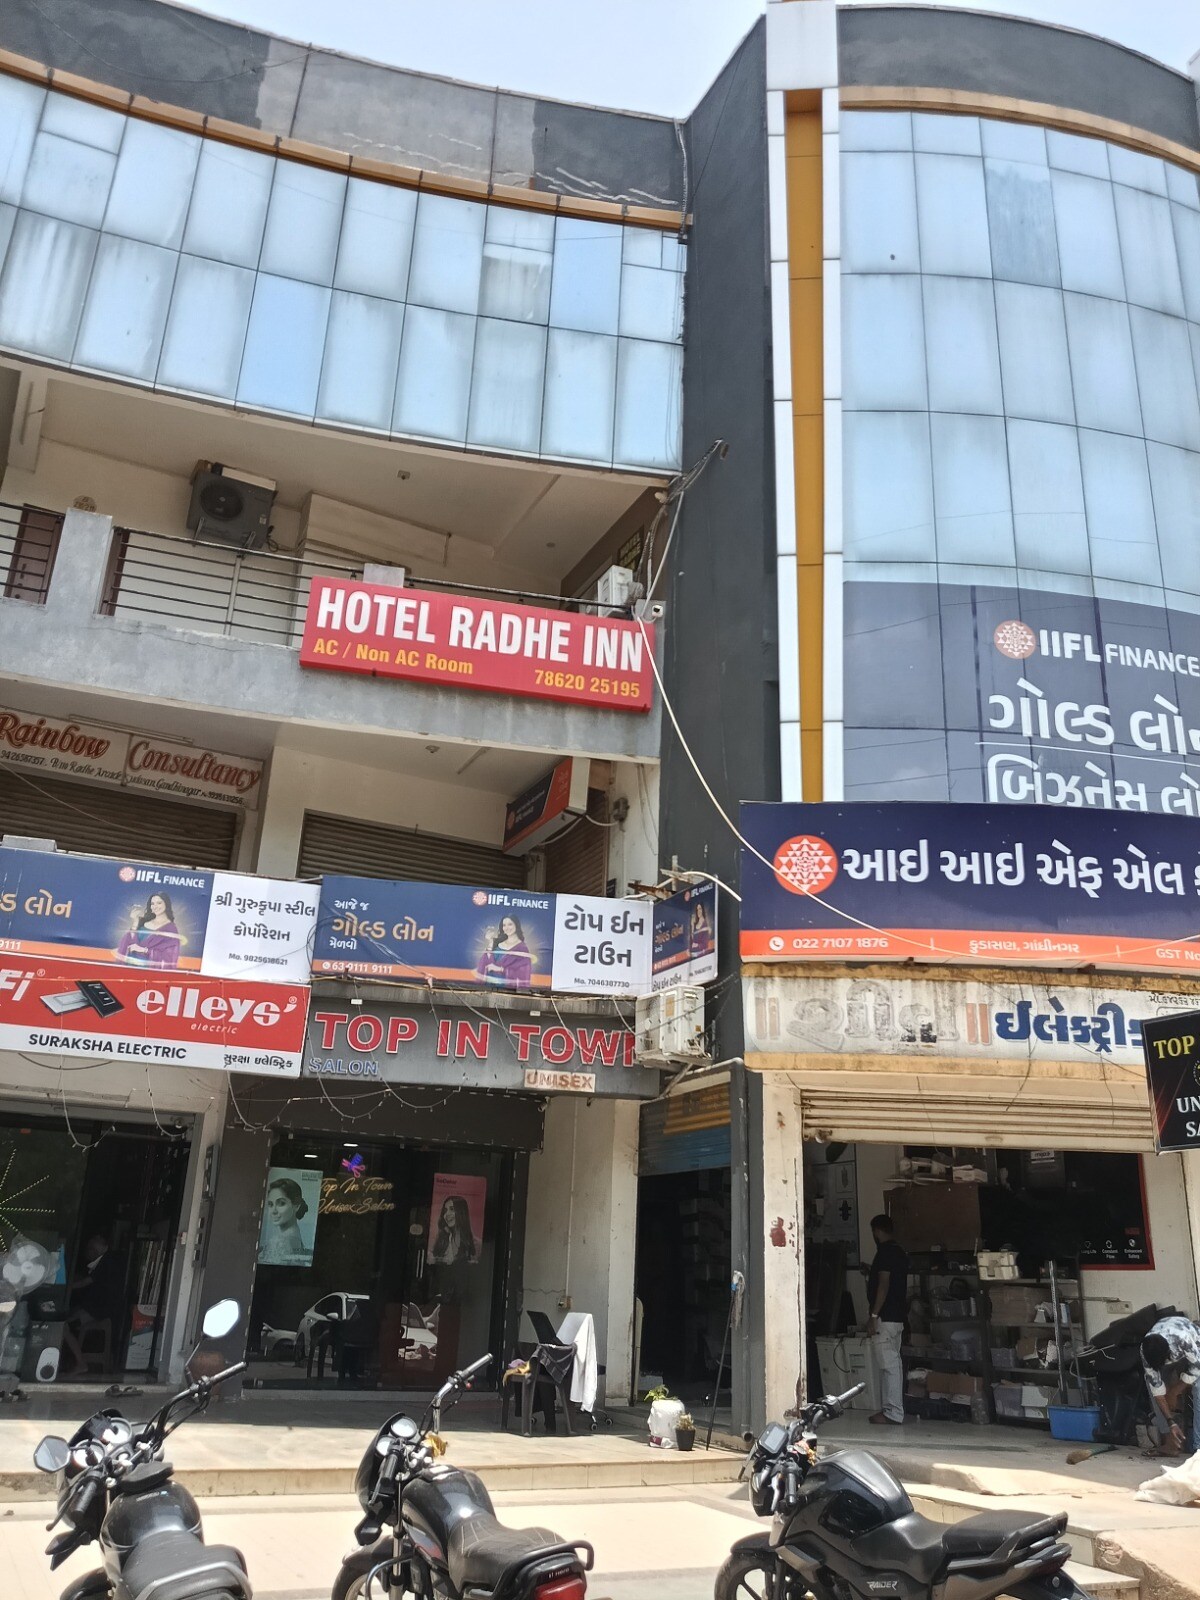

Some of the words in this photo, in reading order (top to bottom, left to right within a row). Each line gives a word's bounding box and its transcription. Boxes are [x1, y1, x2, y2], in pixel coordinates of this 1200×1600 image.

[316, 586, 435, 644] HOTEL
[449, 605, 571, 663] RADHE
[583, 624, 643, 673] INN
[313, 638, 339, 656] AC
[342, 641, 351, 659] /
[355, 644, 389, 663] Non
[395, 650, 420, 668] AC
[425, 654, 473, 675] Room
[1039, 629, 1101, 663] IIFL
[1104, 643, 1200, 677] FINANCE
[534, 669, 585, 691] 78620
[590, 676, 640, 698] 25195
[0, 711, 111, 759] Rainbow
[127, 740, 262, 794] Consultancy
[136, 869, 161, 883] IIFL
[163, 875, 205, 889] FINANCE
[1035, 838, 1103, 898] એફ
[1112, 843, 1186, 895] એલ
[24, 888, 73, 918] લોન
[214, 891, 233, 907] શ્રી
[284, 900, 316, 917] સ્ટીલ
[334, 898, 358, 911] આજે
[359, 902, 370, 911] જ
[488, 893, 511, 906] IIFL
[512, 898, 549, 910] FINANCE
[331, 911, 386, 939] ગોલ્ડ
[392, 915, 434, 942] લોન
[564, 905, 604, 932] ટોપ
[610, 910, 645, 936] ઈન
[329, 936, 357, 950] મેળવો
[574, 941, 633, 967] ટાઉન
[792, 937, 818, 950] 022
[821, 937, 854, 949] 7107
[855, 937, 889, 949] 1876
[1155, 948, 1181, 960] GST
[372, 965, 393, 974] 9111
[573, 977, 586, 985] Mo.
[190, 1022, 238, 1035] electric
[315, 1012, 418, 1053] TOP
[436, 1019, 490, 1059] IN
[28, 1033, 114, 1053] SURAKSHA
[117, 1042, 187, 1060] ELECTRIC
[1153, 1035, 1195, 1060] TOP
[224, 1054, 250, 1066] સુરક્ષા
[308, 1057, 379, 1076] SALON
[526, 1071, 594, 1090] UNISEX
[320, 1177, 338, 1198] Top
[340, 1177, 359, 1194] In
[362, 1176, 393, 1193] Town
[318, 1198, 356, 1214] Unisex
[356, 1197, 395, 1214] Salon
[866, 1580, 898, 1591] RAIDER
